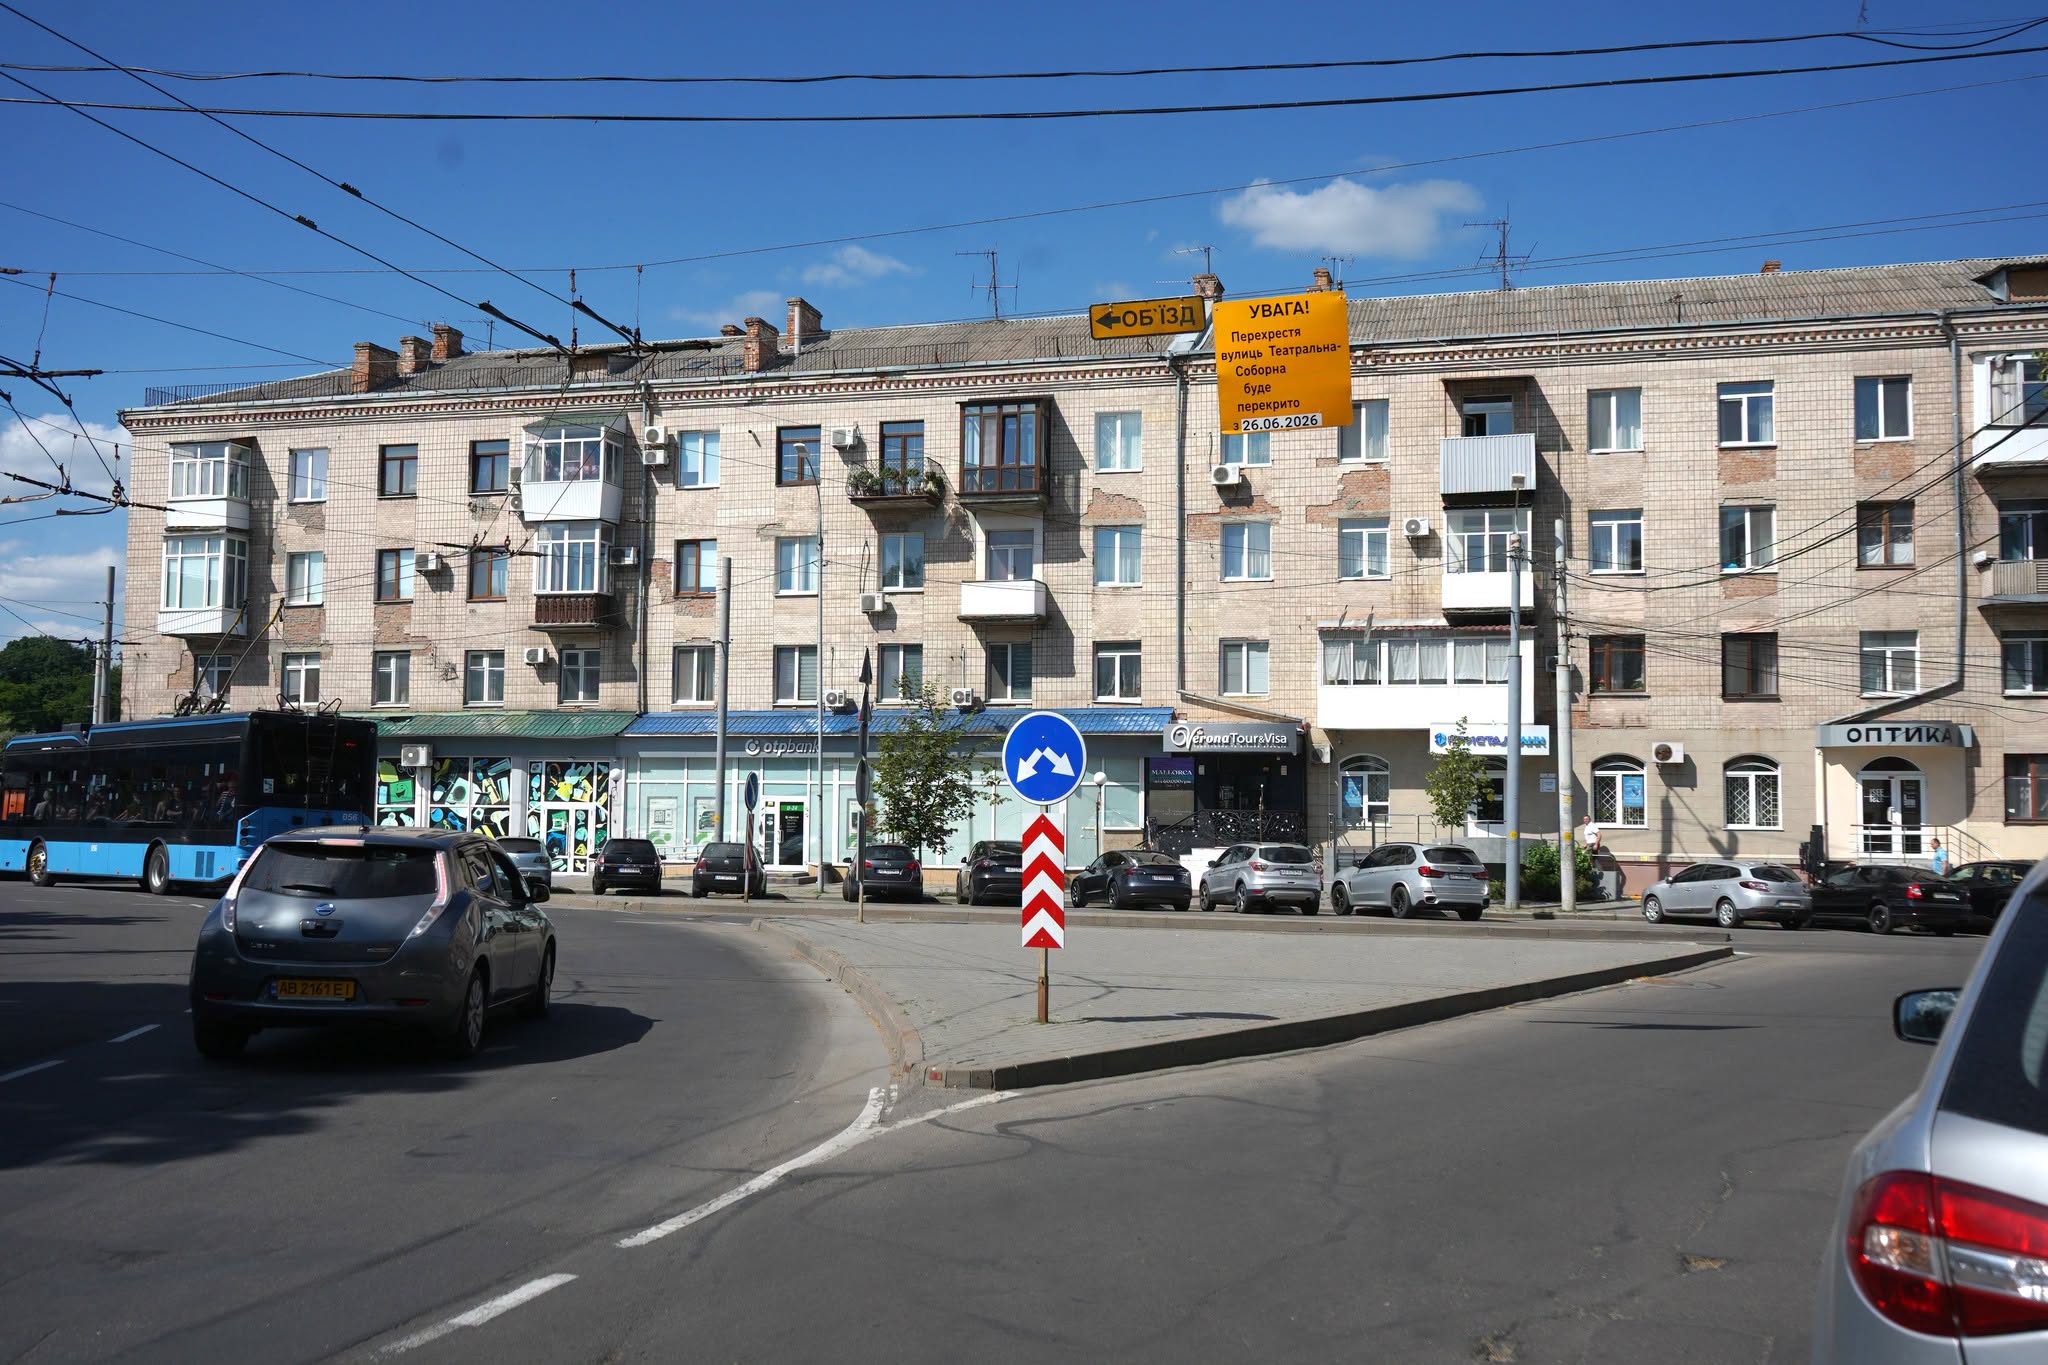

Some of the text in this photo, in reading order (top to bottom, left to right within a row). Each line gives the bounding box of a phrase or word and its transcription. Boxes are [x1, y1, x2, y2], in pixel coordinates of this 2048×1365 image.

[1249, 300, 1309, 319] УВАГА!
[1231, 328, 1301, 343] Перехрестя
[1221, 343, 1342, 362] вулиць Театральна-
[1235, 365, 1286, 377] Соборна
[1243, 383, 1271, 396] буде
[1237, 399, 1300, 413] перекрито
[1242, 415, 1318, 431] 26.06.2026
[1847, 727, 1953, 743] ОПТИКА
